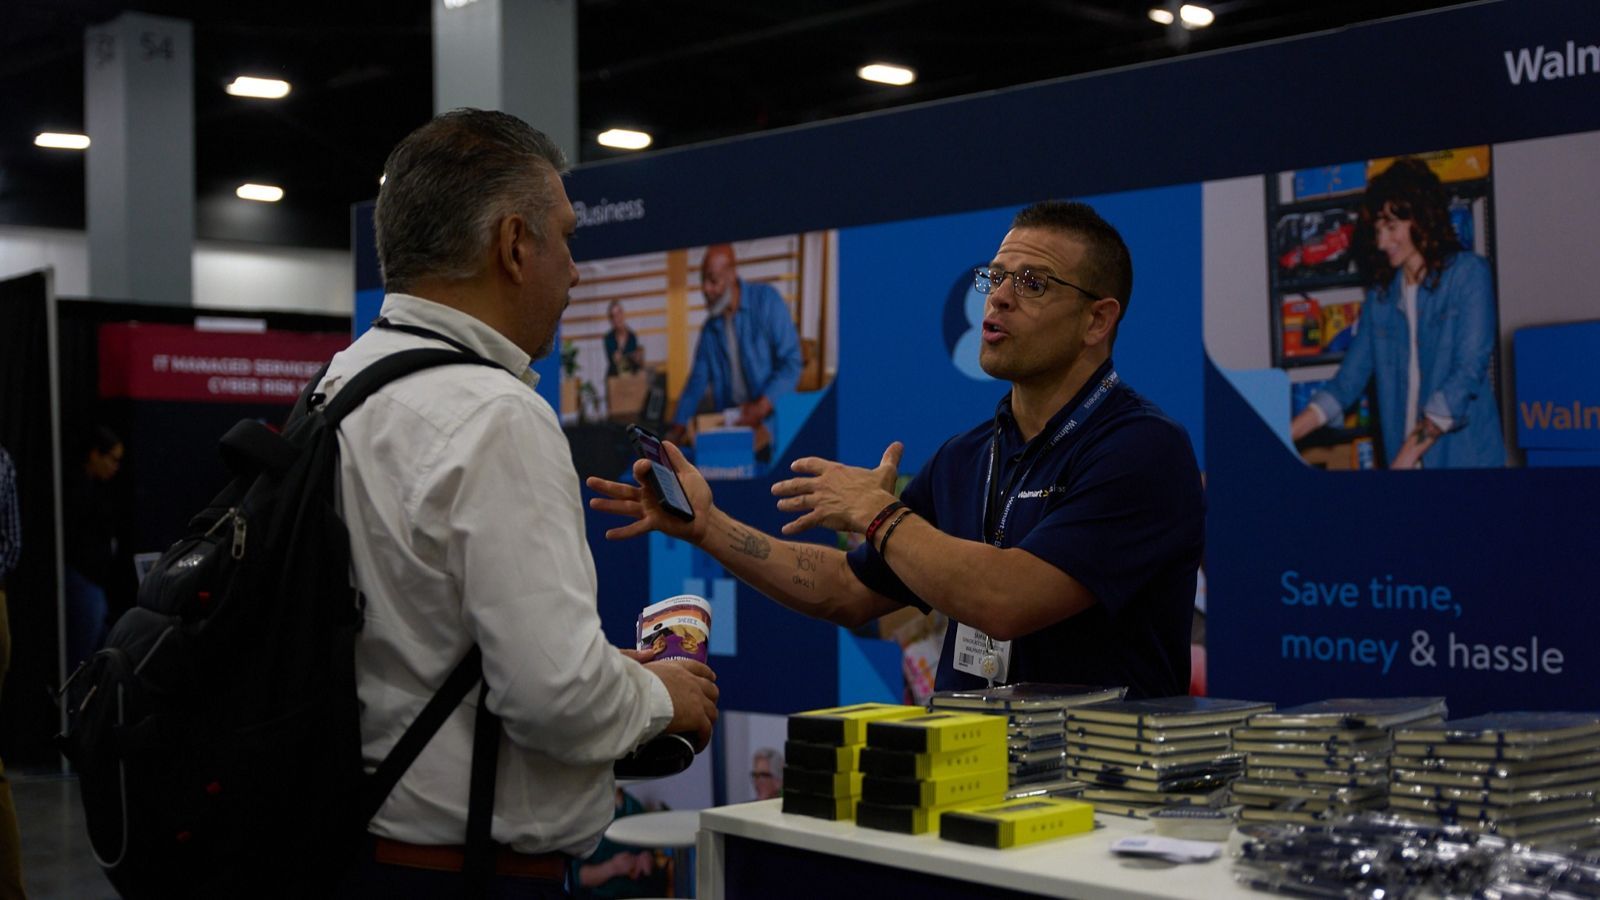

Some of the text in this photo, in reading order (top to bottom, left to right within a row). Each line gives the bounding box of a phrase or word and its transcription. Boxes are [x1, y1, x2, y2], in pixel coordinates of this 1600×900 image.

[171, 354, 253, 376] MANAGED
[207, 375, 261, 395] CYBER
[262, 378, 296, 396] RISK
[1280, 569, 1463, 618] Save time,
[1281, 629, 1565, 676] money & hassle
